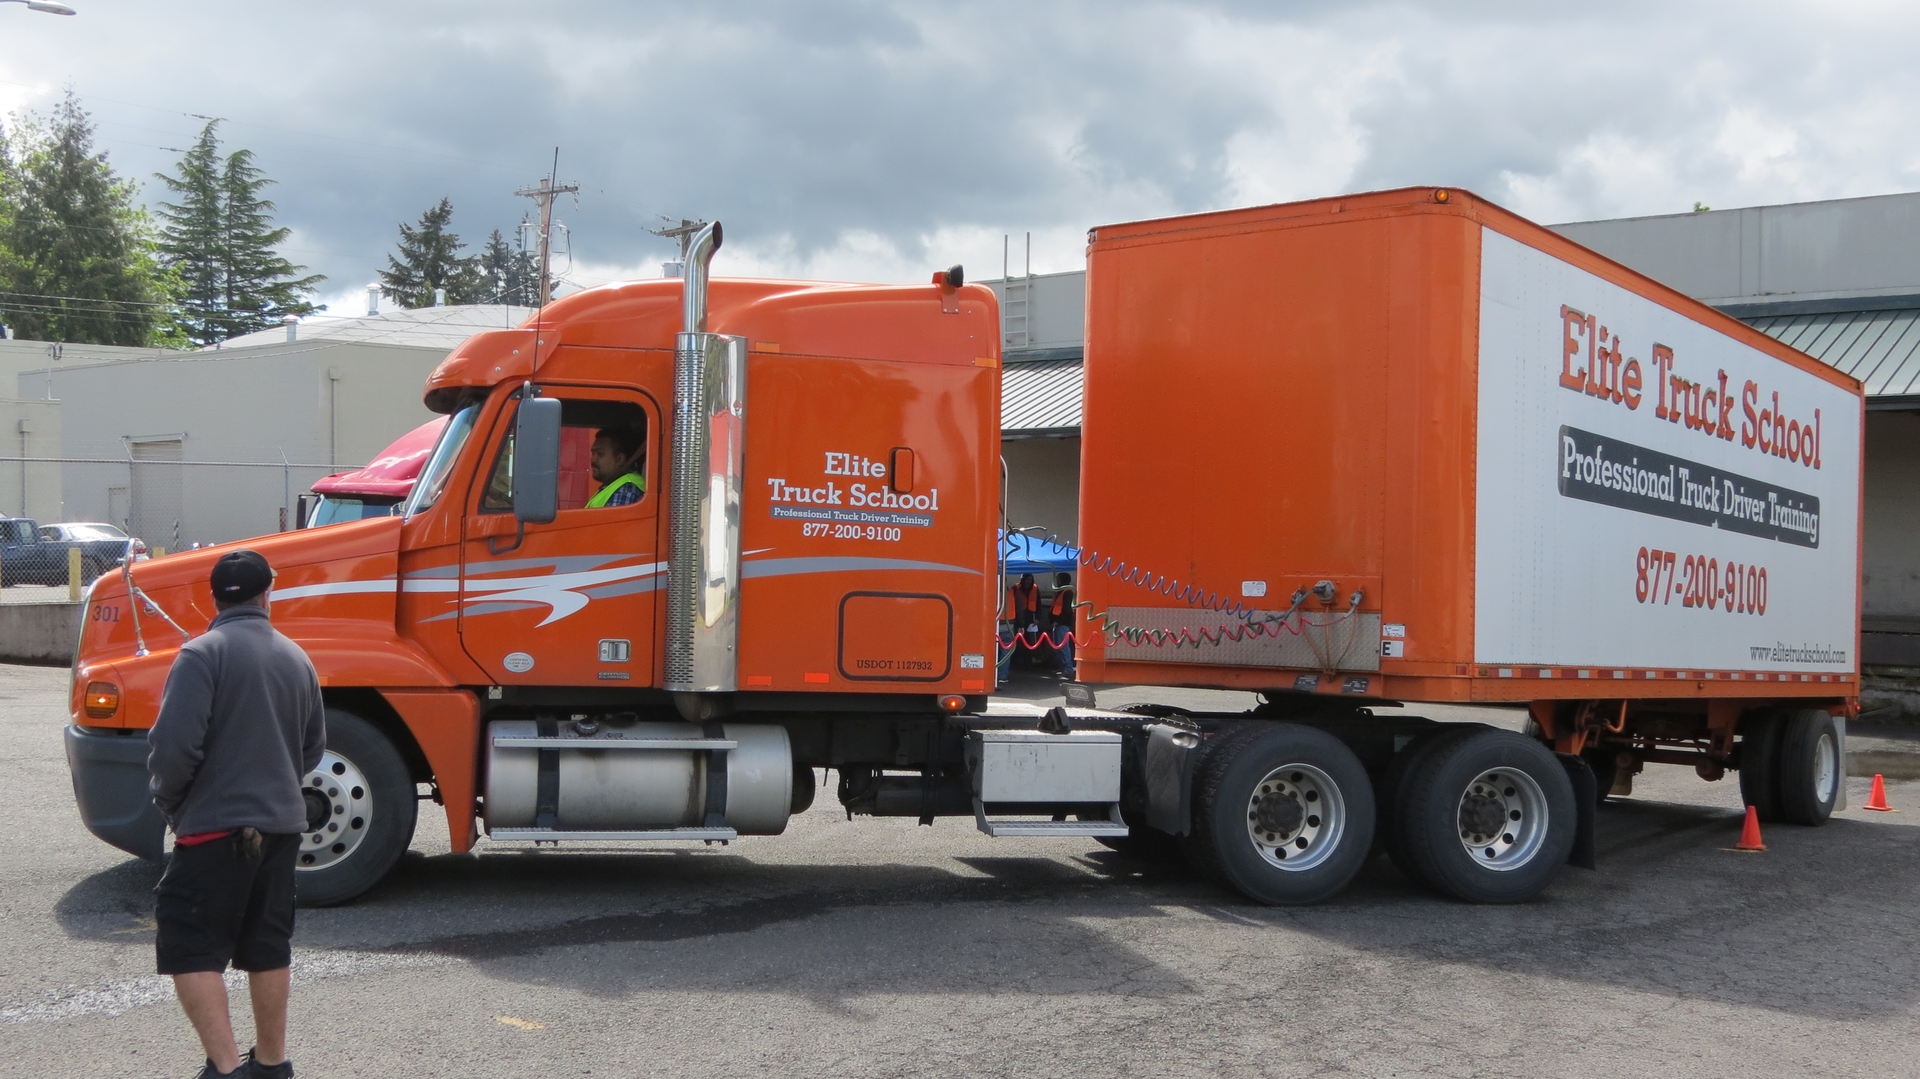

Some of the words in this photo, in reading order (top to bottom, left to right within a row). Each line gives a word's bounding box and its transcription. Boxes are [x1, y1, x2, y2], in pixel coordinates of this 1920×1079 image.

[1558, 303, 1643, 411] Elite
[1652, 342, 1736, 442] Truck
[1741, 379, 1821, 470] School
[824, 451, 886, 478] Elite
[767, 478, 842, 505] Truck
[849, 483, 939, 511] School
[1562, 435, 1675, 504] Professional
[1679, 467, 1720, 513] Truck
[1723, 479, 1766, 524] Driver
[1768, 492, 1819, 544] Training
[773, 507, 831, 519] Professional
[833, 511, 859, 521] Truck
[861, 513, 889, 523] Driver
[891, 514, 929, 527] Training
[802, 522, 901, 541] 877-200-9100
[1635, 545, 1768, 617] 877-200-9100
[93, 605, 119, 622] 301
[1382, 642, 1391, 656] E
[1750, 641, 1846, 664] www.elitetruckschool.com
[856, 660, 894, 670] USDOT
[896, 660, 932, 670] 1127932
